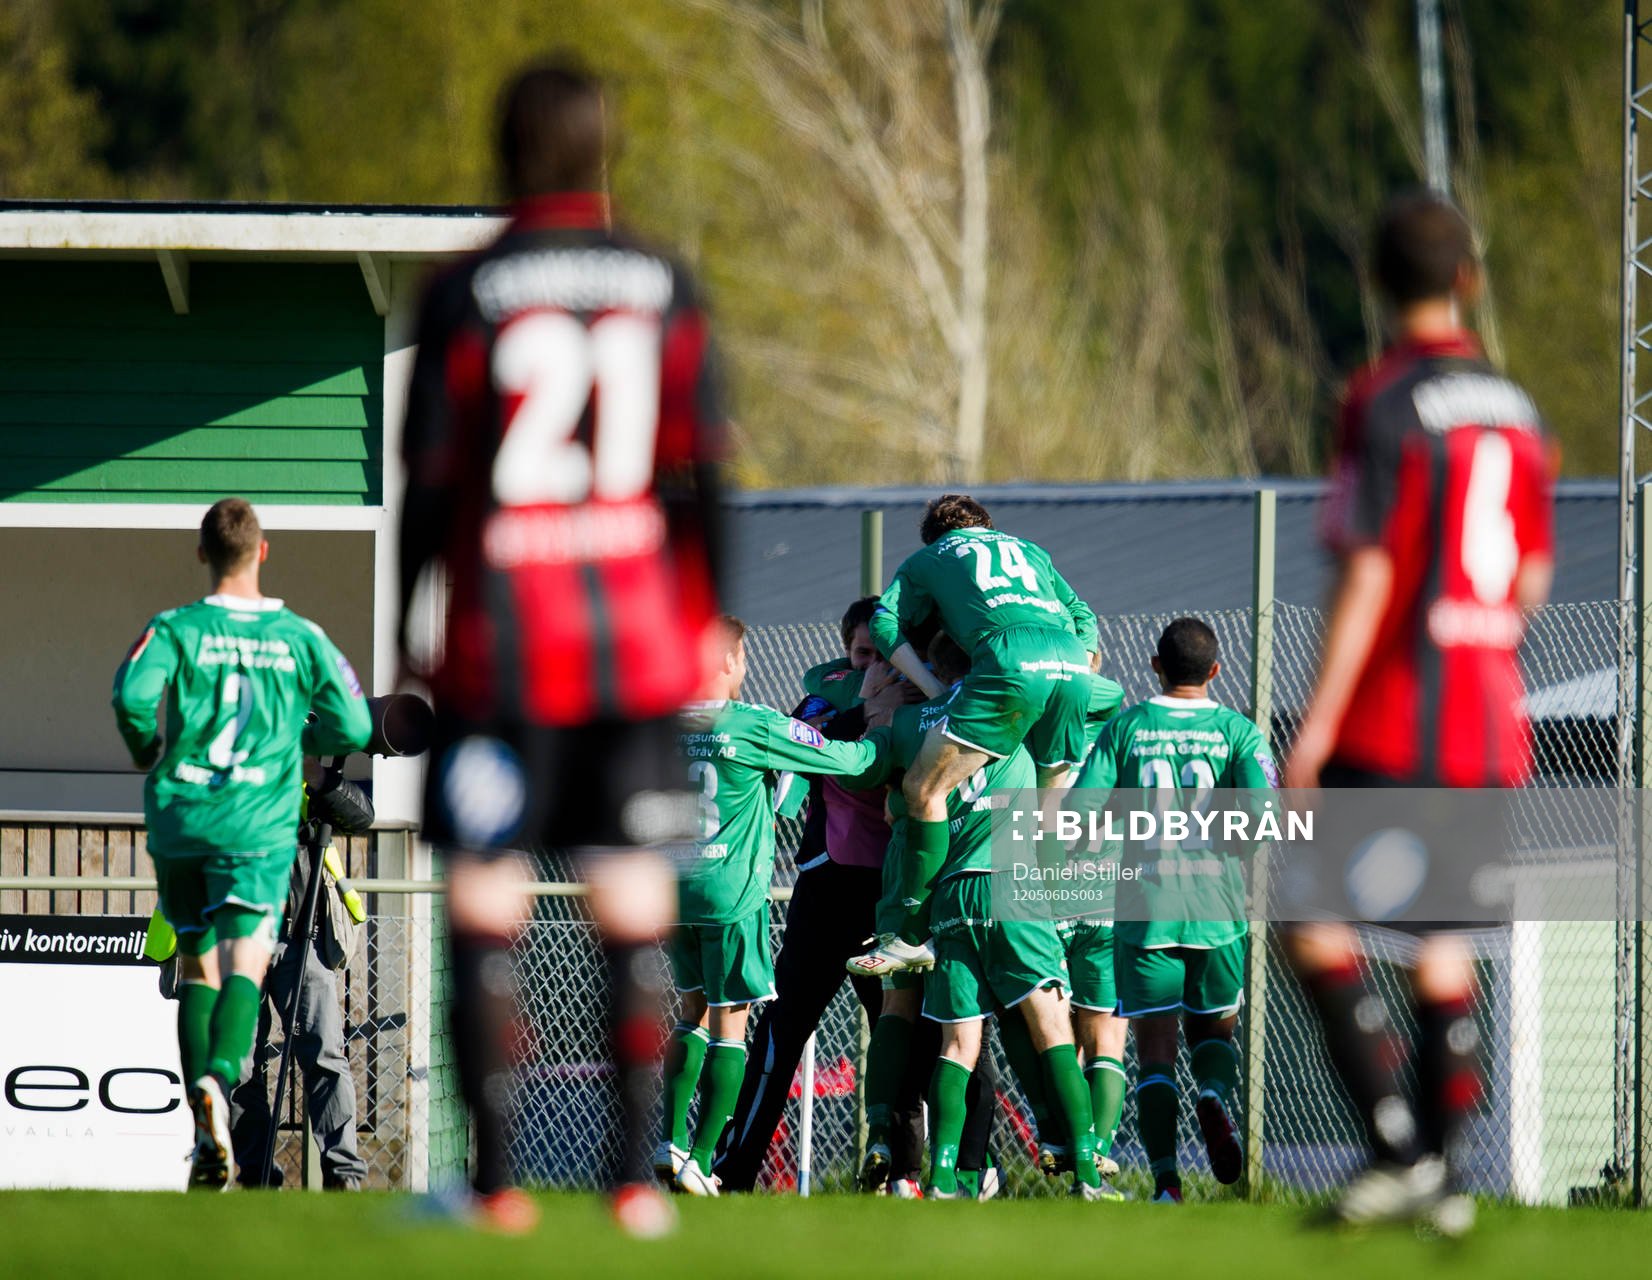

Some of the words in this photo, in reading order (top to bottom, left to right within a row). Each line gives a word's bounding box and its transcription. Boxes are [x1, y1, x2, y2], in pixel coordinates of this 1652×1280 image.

[491, 310, 664, 506] 21
[955, 541, 1038, 592] 24
[717, 745, 736, 757] AB
[4, 1065, 181, 1115] ec
[5, 1126, 95, 1138] VALLA
